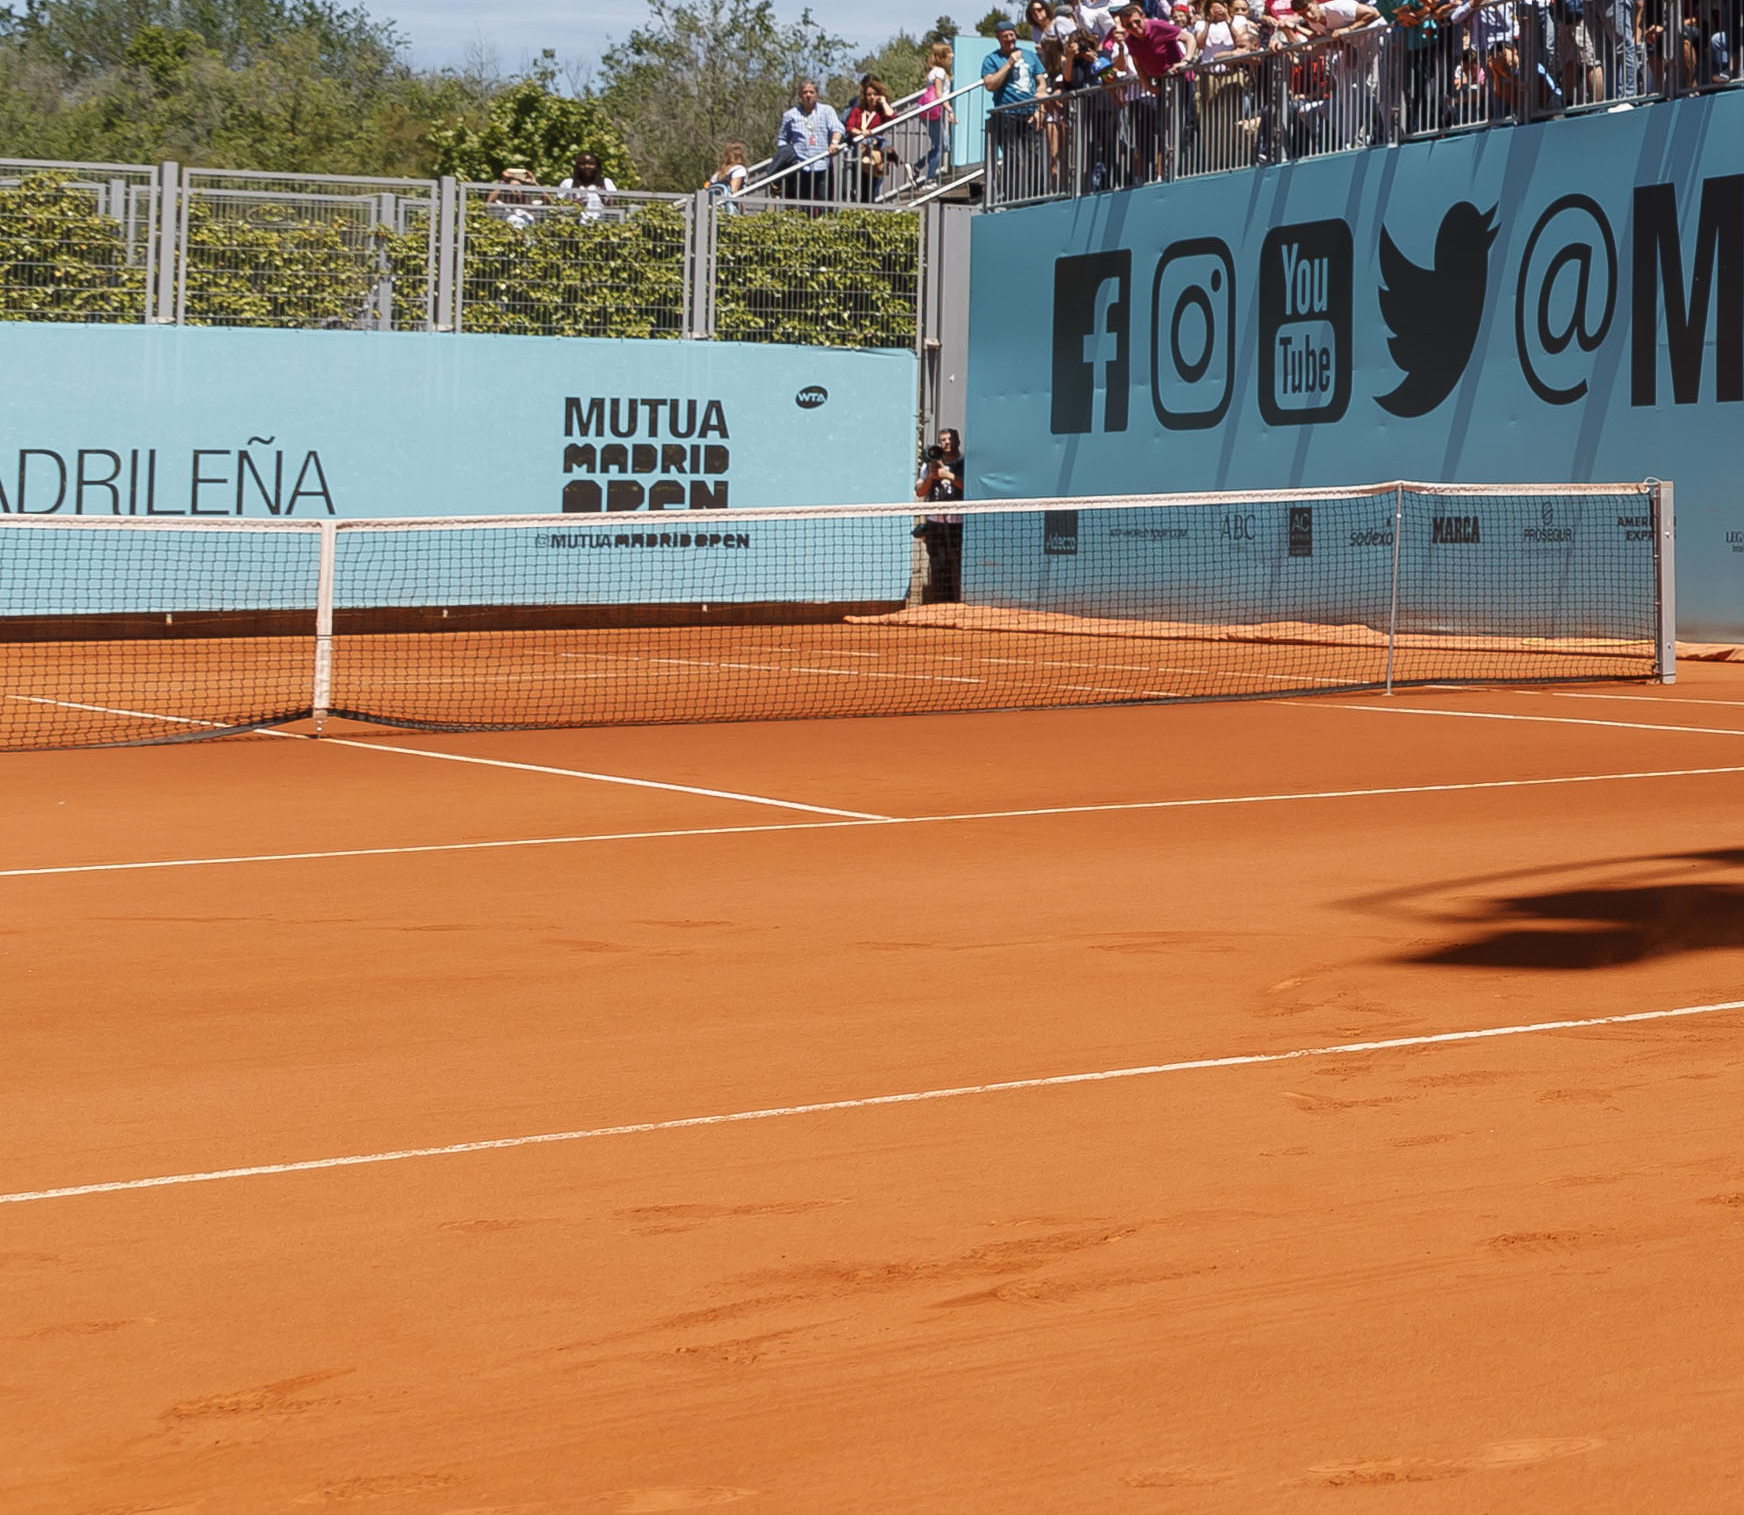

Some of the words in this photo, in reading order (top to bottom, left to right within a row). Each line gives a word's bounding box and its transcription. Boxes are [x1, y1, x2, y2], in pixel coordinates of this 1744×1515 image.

[1281, 242, 1329, 316] You
[1279, 333, 1331, 395] Tube
[798, 392, 825, 403] WTA
[564, 396, 730, 439] MUTUA
[562, 443, 730, 474] MADRID
[562, 479, 729, 513] OPEN
[1220, 513, 1256, 541] ABC
[1432, 516, 1481, 544] MARCA
